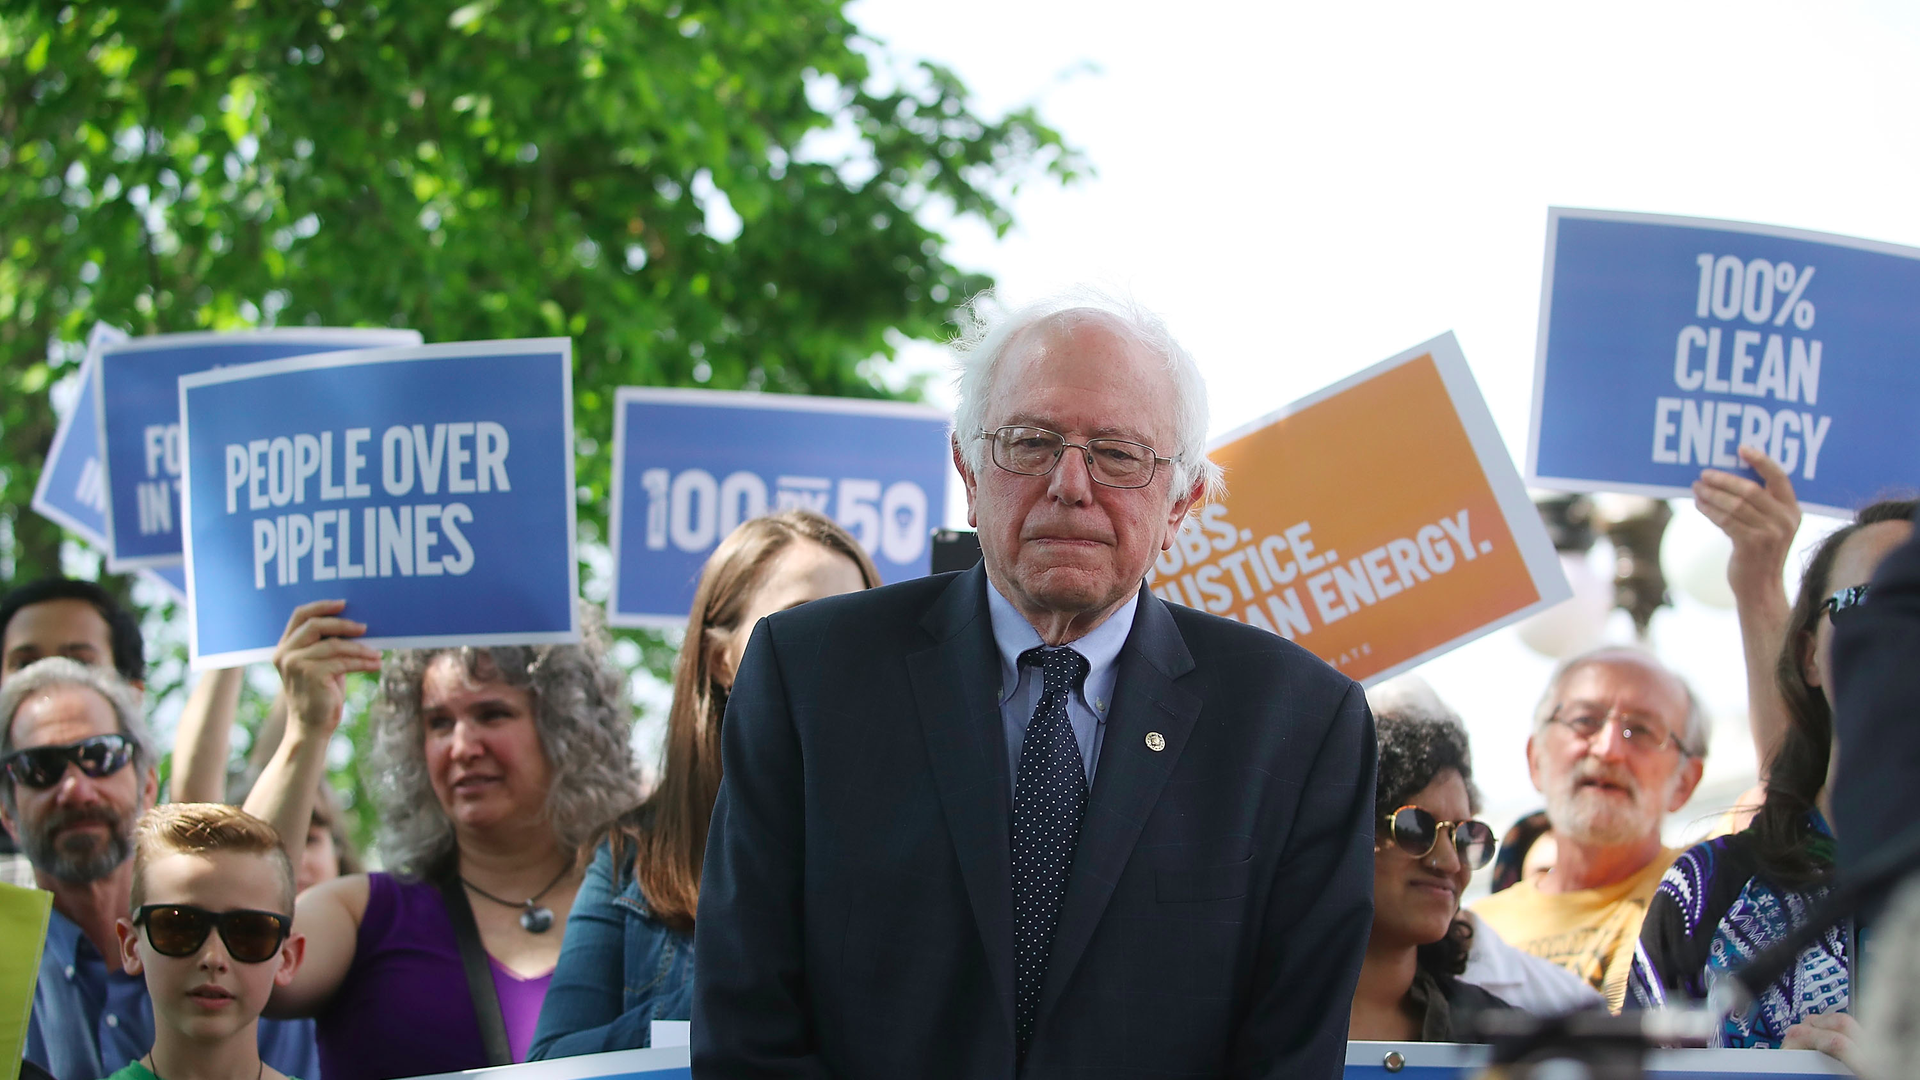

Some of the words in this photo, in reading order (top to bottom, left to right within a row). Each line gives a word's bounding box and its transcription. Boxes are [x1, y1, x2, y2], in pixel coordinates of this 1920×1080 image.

[1696, 253, 1816, 331] 100%
[1673, 325, 1823, 406] CLEAN
[225, 427, 371, 515] PEOPLE
[381, 421, 512, 497] OVER
[1652, 397, 1832, 480] ENERGY
[252, 502, 476, 591] PIPELINES
[641, 467, 768, 553] 100
[836, 478, 928, 565] 50
[1146, 503, 1254, 586] OBS.
[1153, 520, 1339, 613] USTICE.
[1306, 508, 1494, 626] ENERGY.
